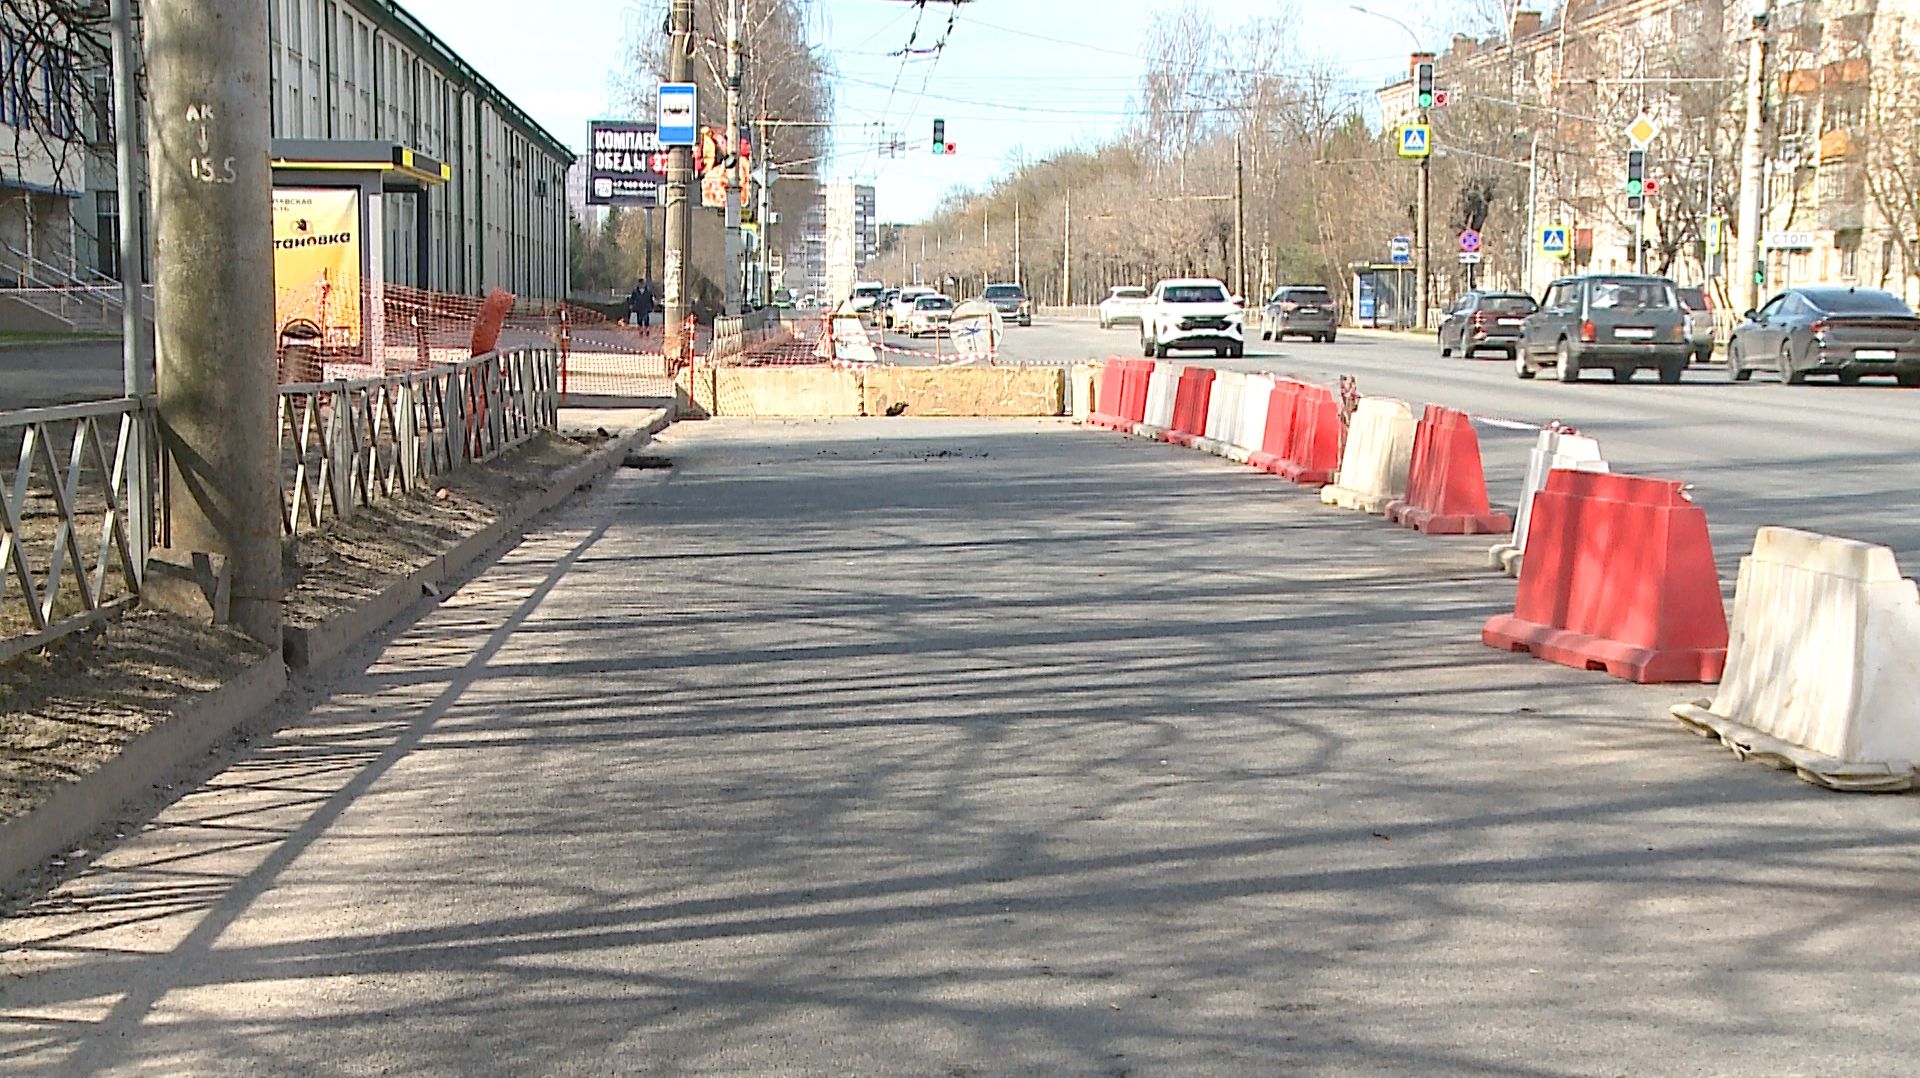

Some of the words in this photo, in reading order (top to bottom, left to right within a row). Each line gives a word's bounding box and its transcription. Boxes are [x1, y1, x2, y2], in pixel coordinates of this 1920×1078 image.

[595, 130, 666, 150] КОМПЛЕК
[595, 151, 646, 173] ОБЕДЫ
[274, 232, 351, 249] тановка
[1773, 234, 1808, 245] СТОП
